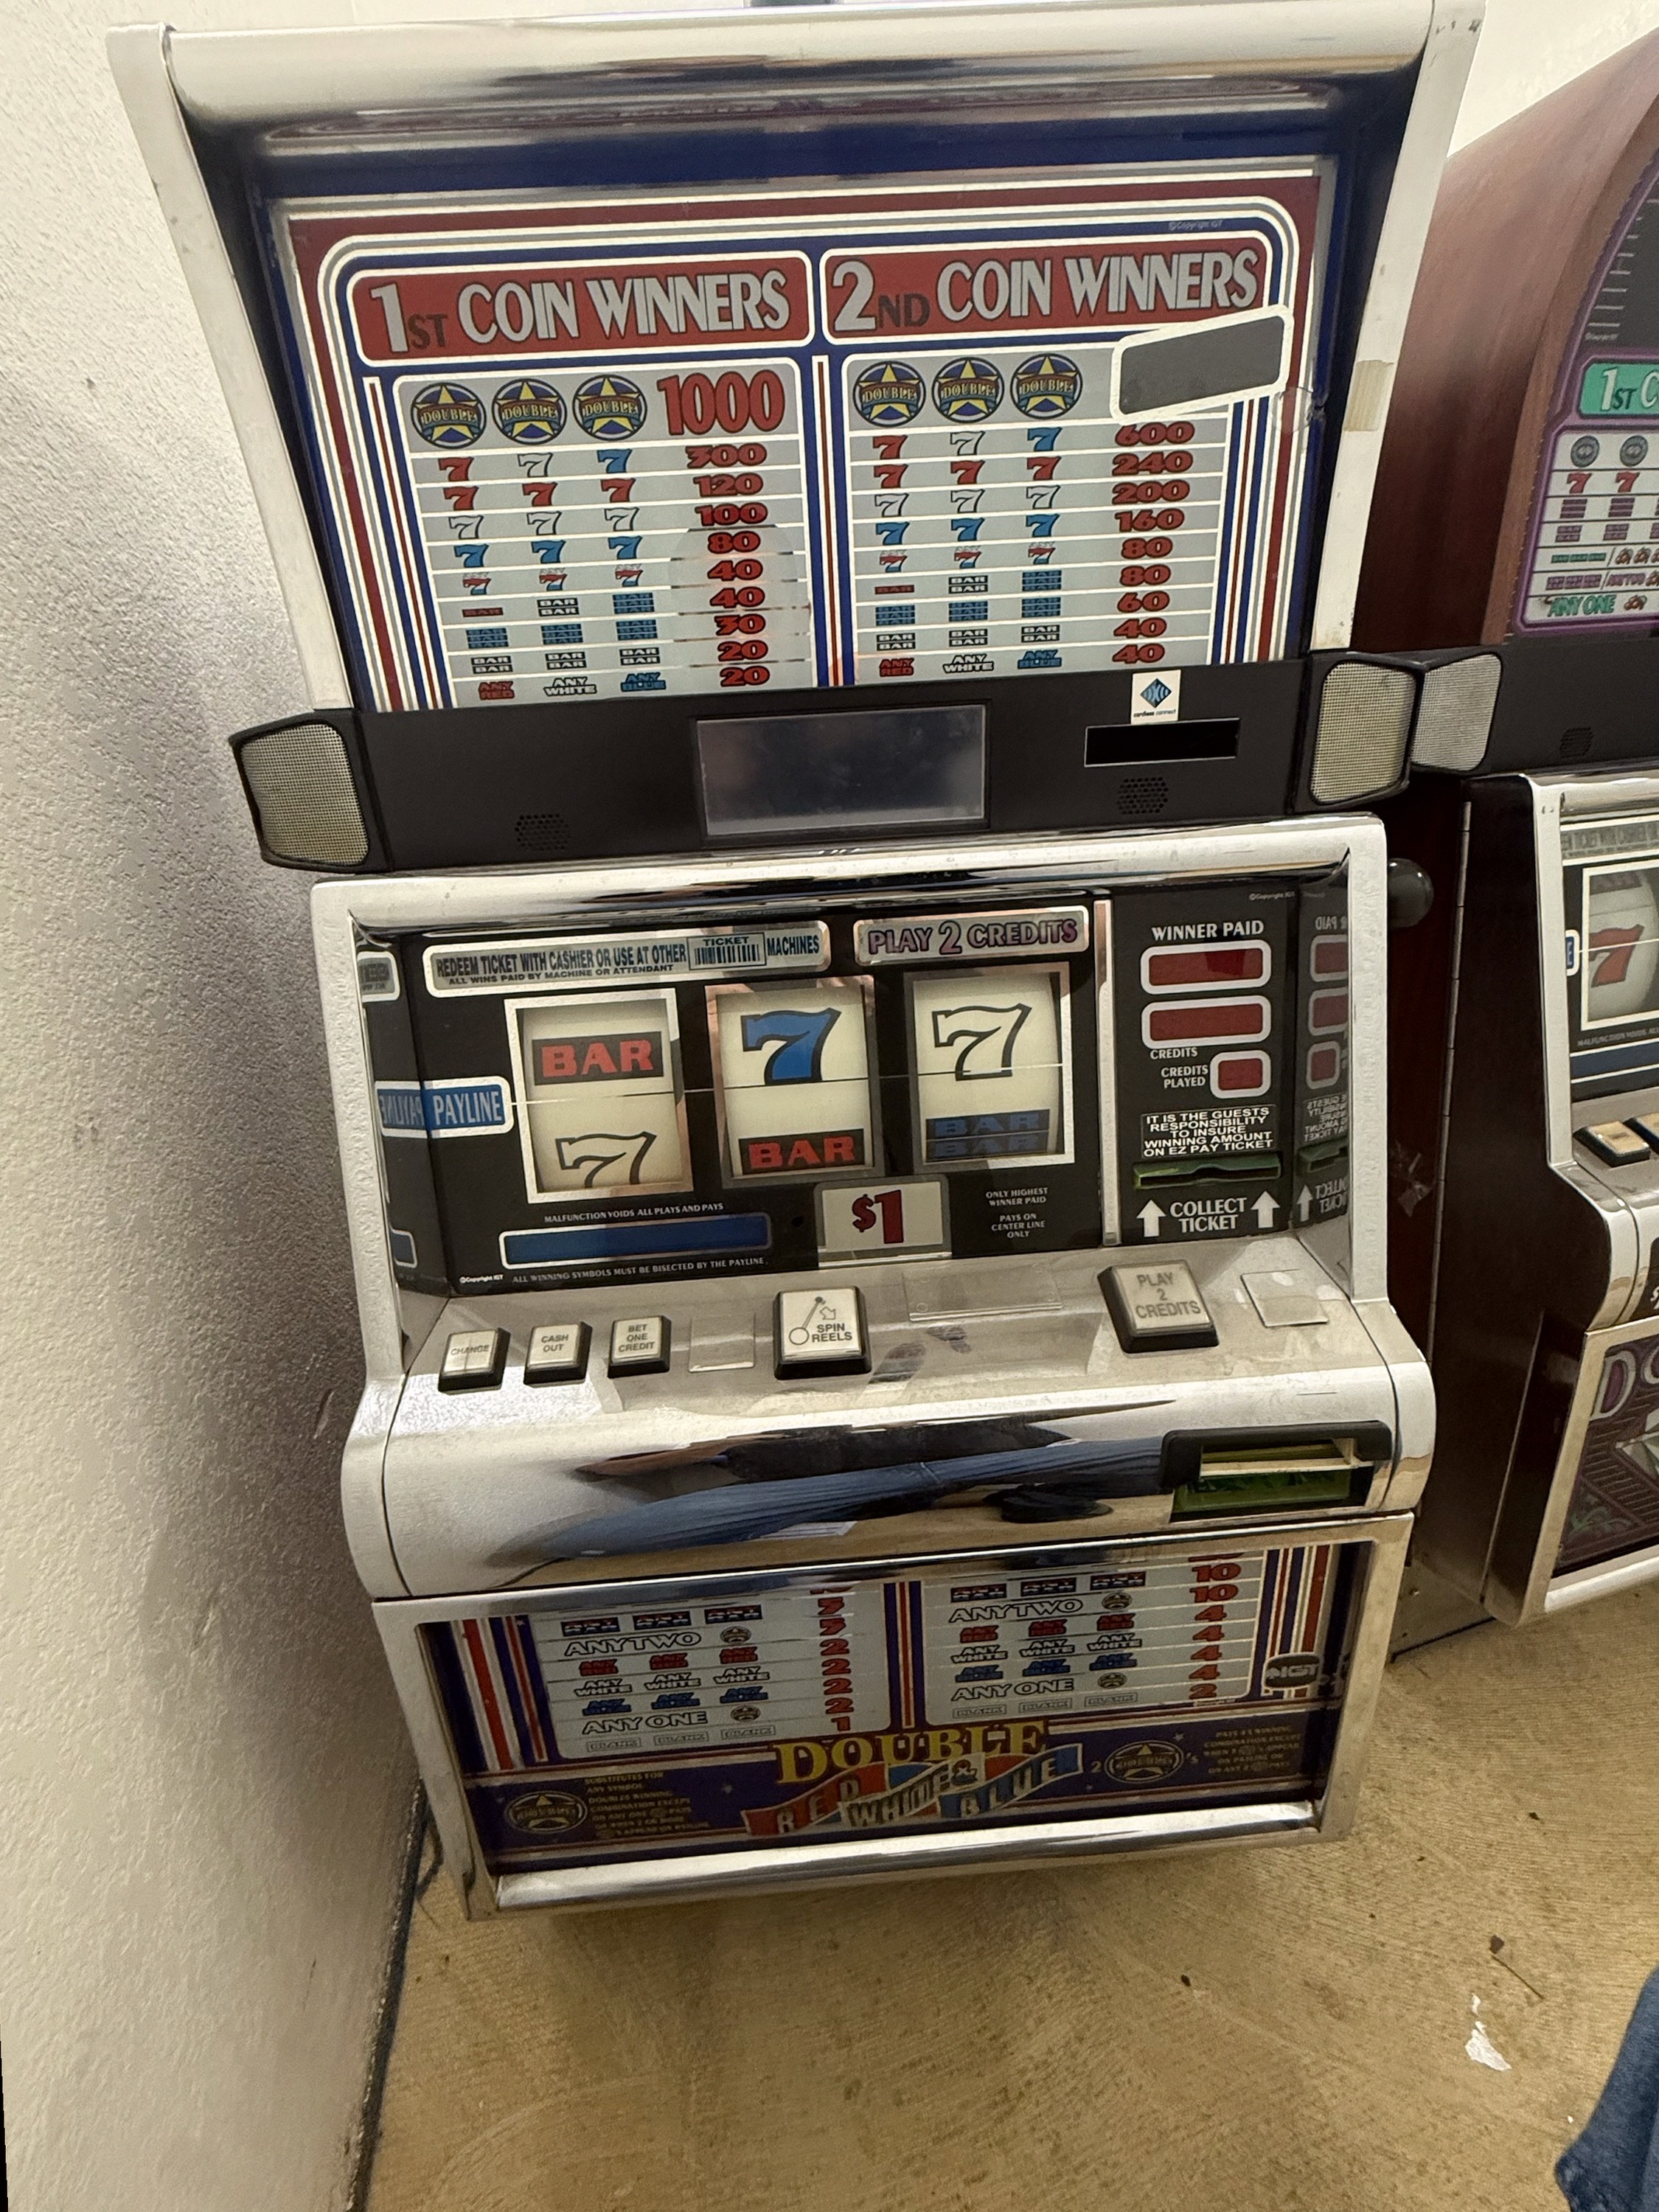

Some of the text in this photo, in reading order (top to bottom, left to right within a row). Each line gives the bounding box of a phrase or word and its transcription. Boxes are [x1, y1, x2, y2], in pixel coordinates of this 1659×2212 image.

[832, 248, 1259, 332] 2ND COIN WINNERS
[371, 270, 790, 352] 1ST COIN WINNERS
[862, 386, 917, 403] DOUBLE
[941, 382, 995, 399] DOUBLE
[1019, 378, 1074, 395] DOUBLE
[584, 401, 639, 417] DOUBLE
[657, 369, 786, 435] 1000
[421, 408, 478, 425] DOUBLE
[503, 405, 559, 421] DOUBLE
[1115, 421, 1195, 447] 600
[685, 442, 767, 469] 300
[1112, 450, 1194, 476] 240
[692, 473, 764, 498] 120
[1112, 479, 1190, 505] 200
[695, 502, 768, 526] 100
[1115, 508, 1184, 532] 160
[707, 531, 761, 554] 80
[1121, 536, 1173, 560] 80
[707, 559, 763, 581] 40
[1119, 564, 1171, 587] 80
[709, 586, 765, 608] 40
[1117, 591, 1170, 613] 60
[1548, 594, 1616, 618] ANY ONE
[714, 613, 766, 636] 30
[1113, 617, 1167, 639] 40
[717, 640, 768, 661] 20
[952, 653, 987, 664] ANY
[1112, 643, 1165, 664] 40
[943, 661, 994, 673] WHITE
[553, 676, 588, 686] ANY
[720, 666, 770, 687] 20
[543, 684, 597, 697] WHITE
[869, 919, 1078, 955] PLAY 2 CREDITS
[1152, 920, 1264, 941] WINNER PAID
[703, 936, 749, 947] TICKET
[767, 935, 820, 956] MACHINES
[437, 944, 686, 977] REDEEM TICKET WITH CASHIER OR USE AT OTHER
[470, 975, 498, 984] WINS
[501, 974, 525, 982] PAID
[544, 969, 593, 979] MACHINE
[596, 968, 610, 976] OR
[612, 964, 674, 975] ATTENDANT
[540, 1039, 653, 1079] BAR
[1150, 1047, 1197, 1060] CREDITS
[1161, 1065, 1208, 1077] CREDITS
[1164, 1077, 1206, 1088] PLAYED
[433, 1090, 504, 1127] PAYLINE
[1147, 1107, 1270, 1124] IT IS THE GUESTS
[1150, 1116, 1266, 1133] RESPONSIBILITY
[1170, 1125, 1246, 1138] TO INSURE
[1144, 1131, 1272, 1149] WINNING AMOUNT
[1144, 1139, 1273, 1157] ON EZ PAY TICKET
[749, 1135, 855, 1169] BAR
[986, 1187, 1048, 1199] ONLY HIGHEST
[990, 1196, 1047, 1206] WINNER PAID
[544, 1203, 723, 1223] MALFUNCTION VOIDS ALL PLAYS AND PAYS
[1169, 1197, 1247, 1217] COLLECT
[852, 1189, 904, 1244] $1
[991, 1220, 1046, 1231] CENTER LINE
[999, 1213, 1037, 1222] PAYS ON
[1179, 1214, 1238, 1234] TICKET
[1006, 1230, 1030, 1239] ONLY
[530, 1272, 570, 1281] WINNING
[572, 1268, 612, 1279] SYMBOLS
[613, 1267, 636, 1276] MUST
[639, 1266, 650, 1274] BE
[653, 1262, 695, 1273] BISECTED
[697, 1262, 708, 1270] BY
[710, 1260, 727, 1268] THE
[1136, 1272, 1173, 1287] PLAY
[1157, 1288, 1168, 1301] 2
[1135, 1300, 1201, 1318] CREDITS
[627, 1324, 647, 1332] BET
[817, 1323, 845, 1333] SPIN
[541, 1334, 569, 1343] CASH
[618, 1341, 655, 1352] CREDIT
[626, 1333, 649, 1342] ONE
[812, 1332, 852, 1343] REELS
[451, 1344, 490, 1356] CHANGE
[543, 1343, 565, 1352] OUT
[1192, 1562, 1242, 1582] 10
[1189, 1583, 1239, 1603] 10
[949, 1599, 1083, 1623] ANY TWO
[1195, 1604, 1227, 1621] 4
[1192, 1624, 1225, 1641] 4
[565, 1632, 701, 1657] ANY TWO
[820, 1638, 849, 1655] 2
[1191, 1644, 1222, 1661] 4
[821, 1658, 851, 1676] 2
[1189, 1664, 1220, 1680] 4
[823, 1677, 852, 1695] 2
[951, 1678, 1074, 1701] ANY ONE
[1189, 1683, 1217, 1700] 2
[825, 1697, 854, 1714] 2
[582, 1711, 708, 1735] ANY ONE
[831, 1716, 850, 1731] 1
[774, 1720, 1048, 1784] DOUBLE
[777, 1778, 860, 1834] RED
[849, 1770, 950, 1827] WHITE
[961, 1757, 1057, 1817] BLUE
